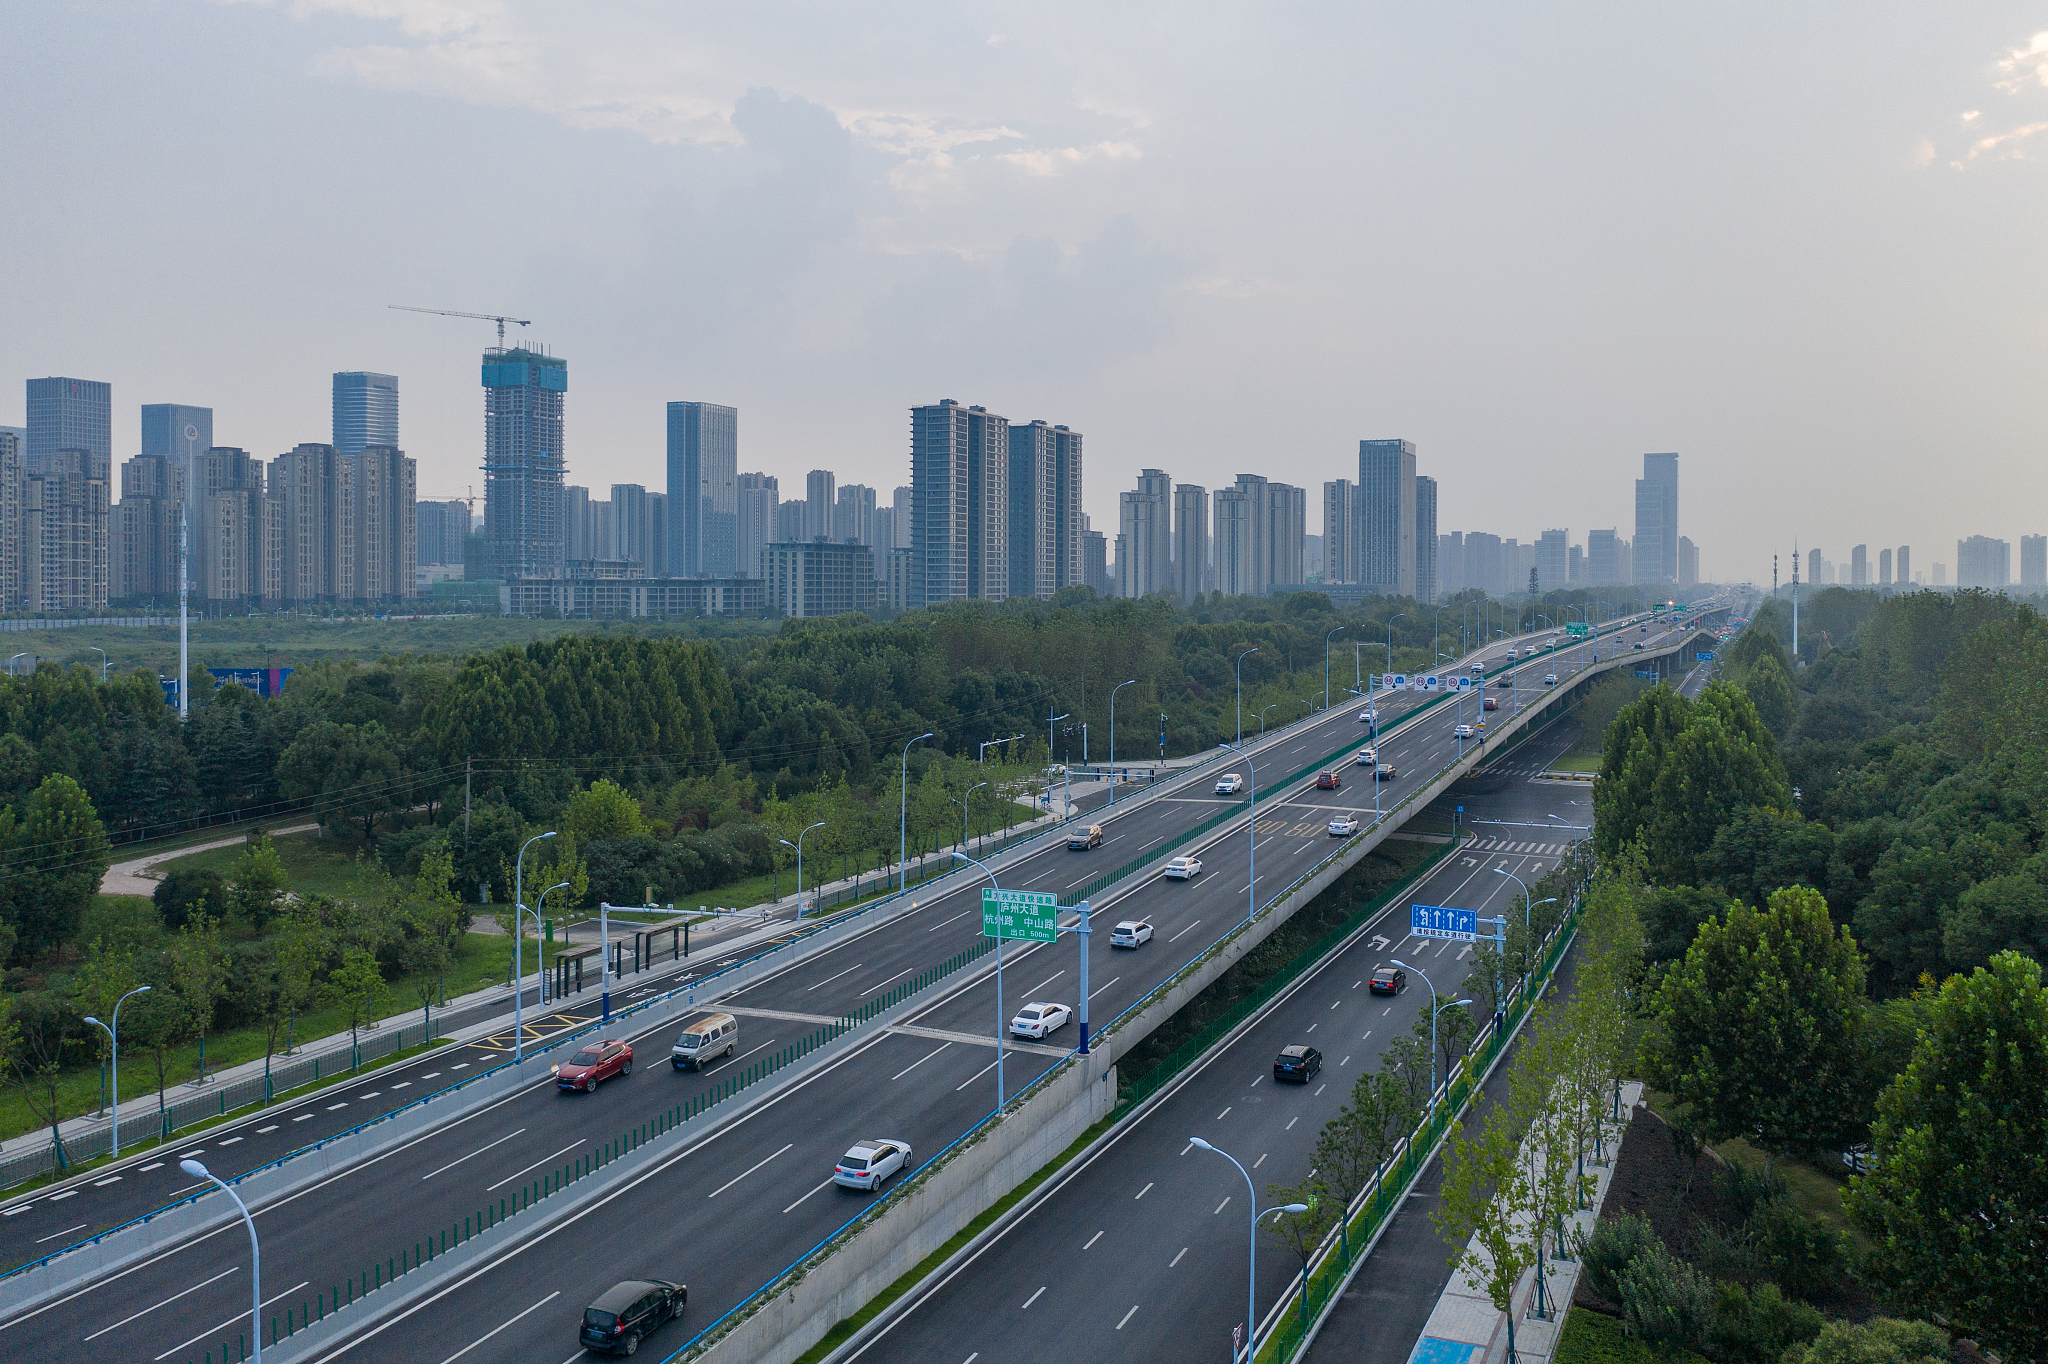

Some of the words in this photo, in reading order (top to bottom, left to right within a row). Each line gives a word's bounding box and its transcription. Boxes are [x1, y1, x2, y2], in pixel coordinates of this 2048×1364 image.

[1001, 902, 1039, 915] 庐州大道
[1024, 917, 1054, 930] 中山路
[1010, 928, 1025, 936] 出口
[1030, 930, 1050, 938] 500m
